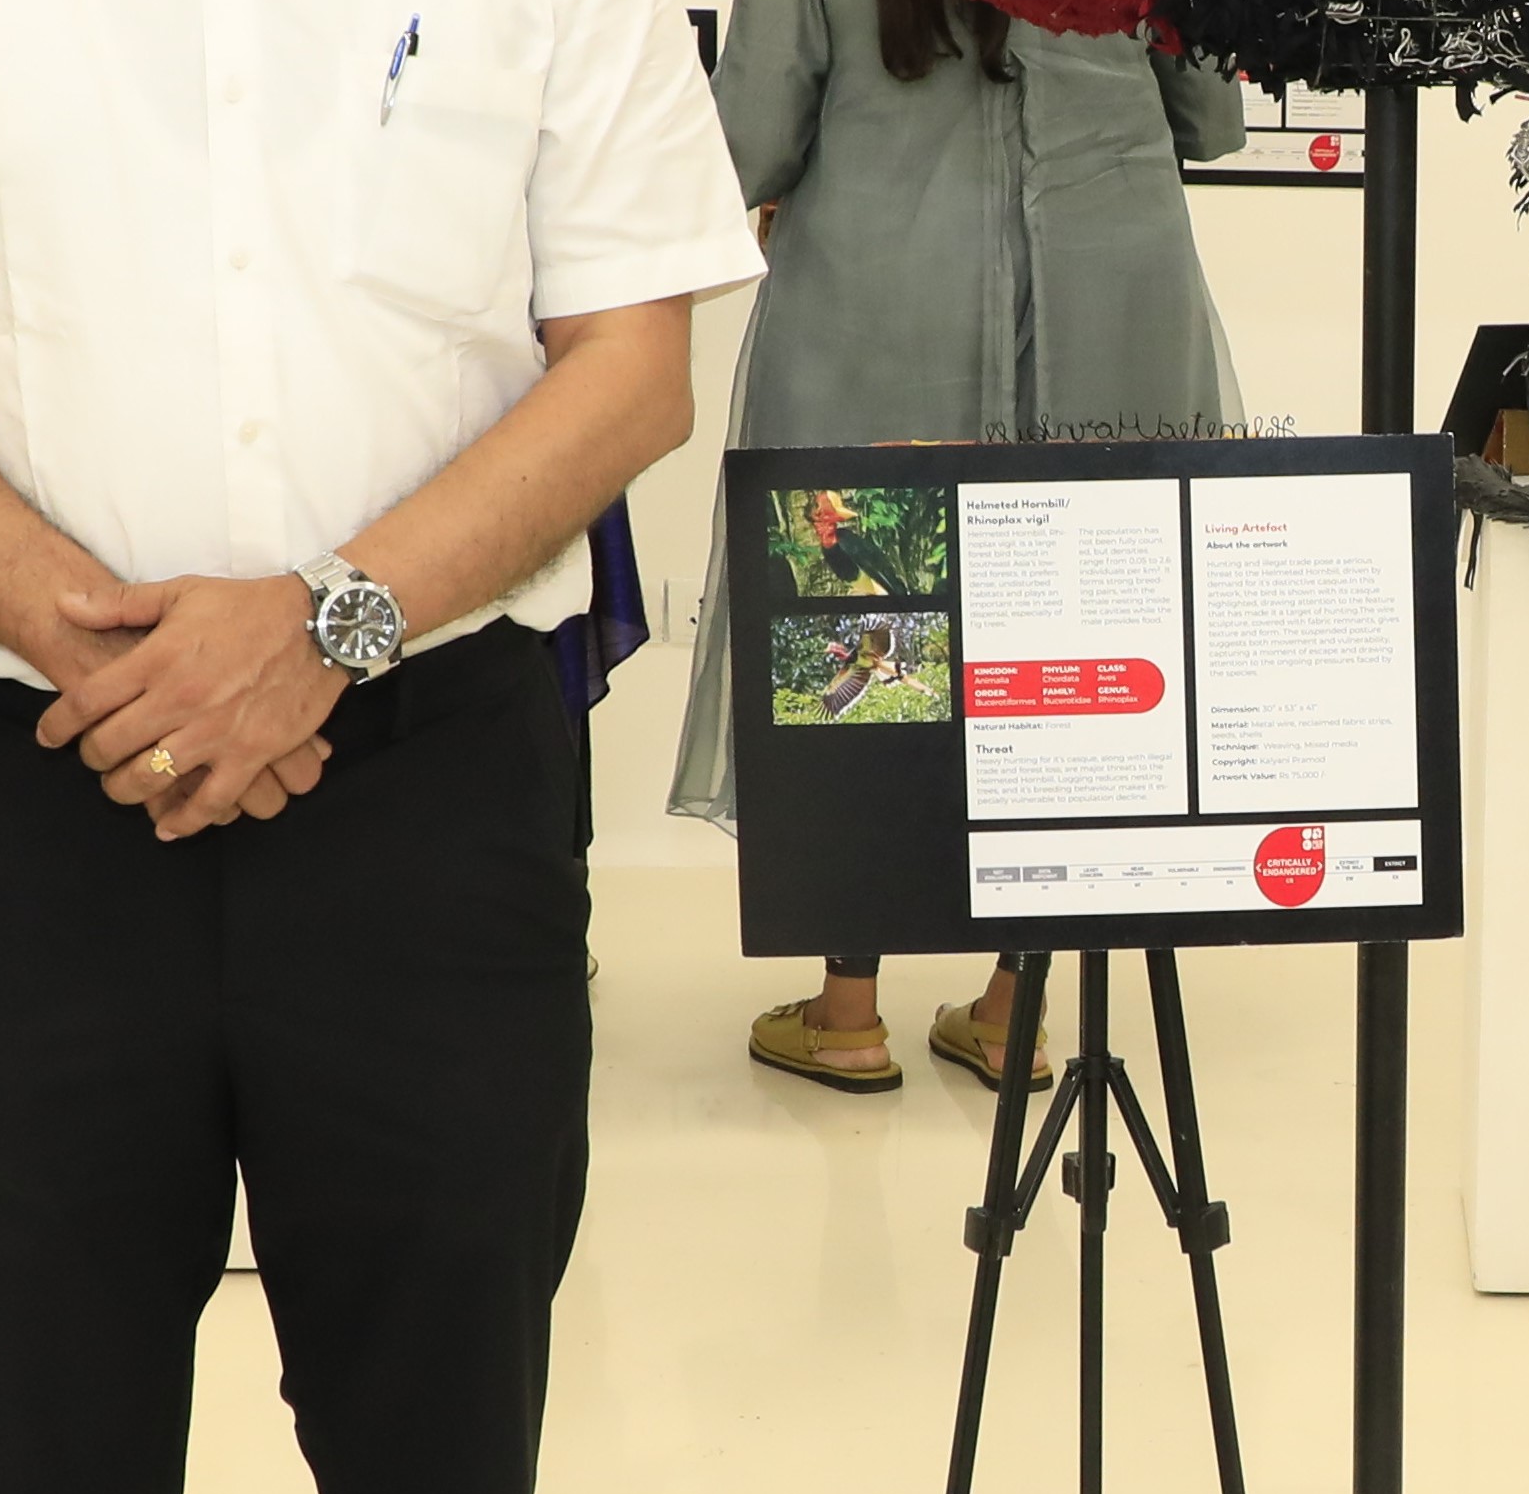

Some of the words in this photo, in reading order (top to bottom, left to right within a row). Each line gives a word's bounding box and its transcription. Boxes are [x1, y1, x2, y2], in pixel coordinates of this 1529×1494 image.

[966, 500, 1019, 511] Helmeted
[1021, 499, 1071, 511] Hornbill/
[967, 515, 1022, 528] Rhinoplax
[1025, 514, 1050, 526] vigil
[1205, 524, 1239, 536] Living
[1241, 523, 1287, 533] Artefact
[1206, 541, 1233, 550] About
[1252, 540, 1288, 548] artwork
[974, 667, 1019, 676] KINGDOM:
[1042, 665, 1081, 674] PHYLUM:
[1097, 664, 1127, 673] CLASS:
[974, 677, 1010, 685] Animalia
[1042, 675, 1080, 683] Chordata
[1097, 674, 1116, 682] Aves
[974, 689, 1008, 698] ORDER:
[1042, 687, 1076, 696] FAMILY:
[1097, 686, 1130, 694] GENUS:
[1210, 705, 1260, 714] Dimension:
[973, 723, 1006, 731] Natural
[1008, 722, 1043, 730] Habitat:
[976, 744, 1013, 754] Threat
[1212, 757, 1258, 768] Copyright:
[1212, 772, 1248, 781] Artwork
[1250, 772, 1277, 780] Value:
[1266, 857, 1313, 867] CRITICALLY
[1263, 867, 1317, 877] ENDANGERED
